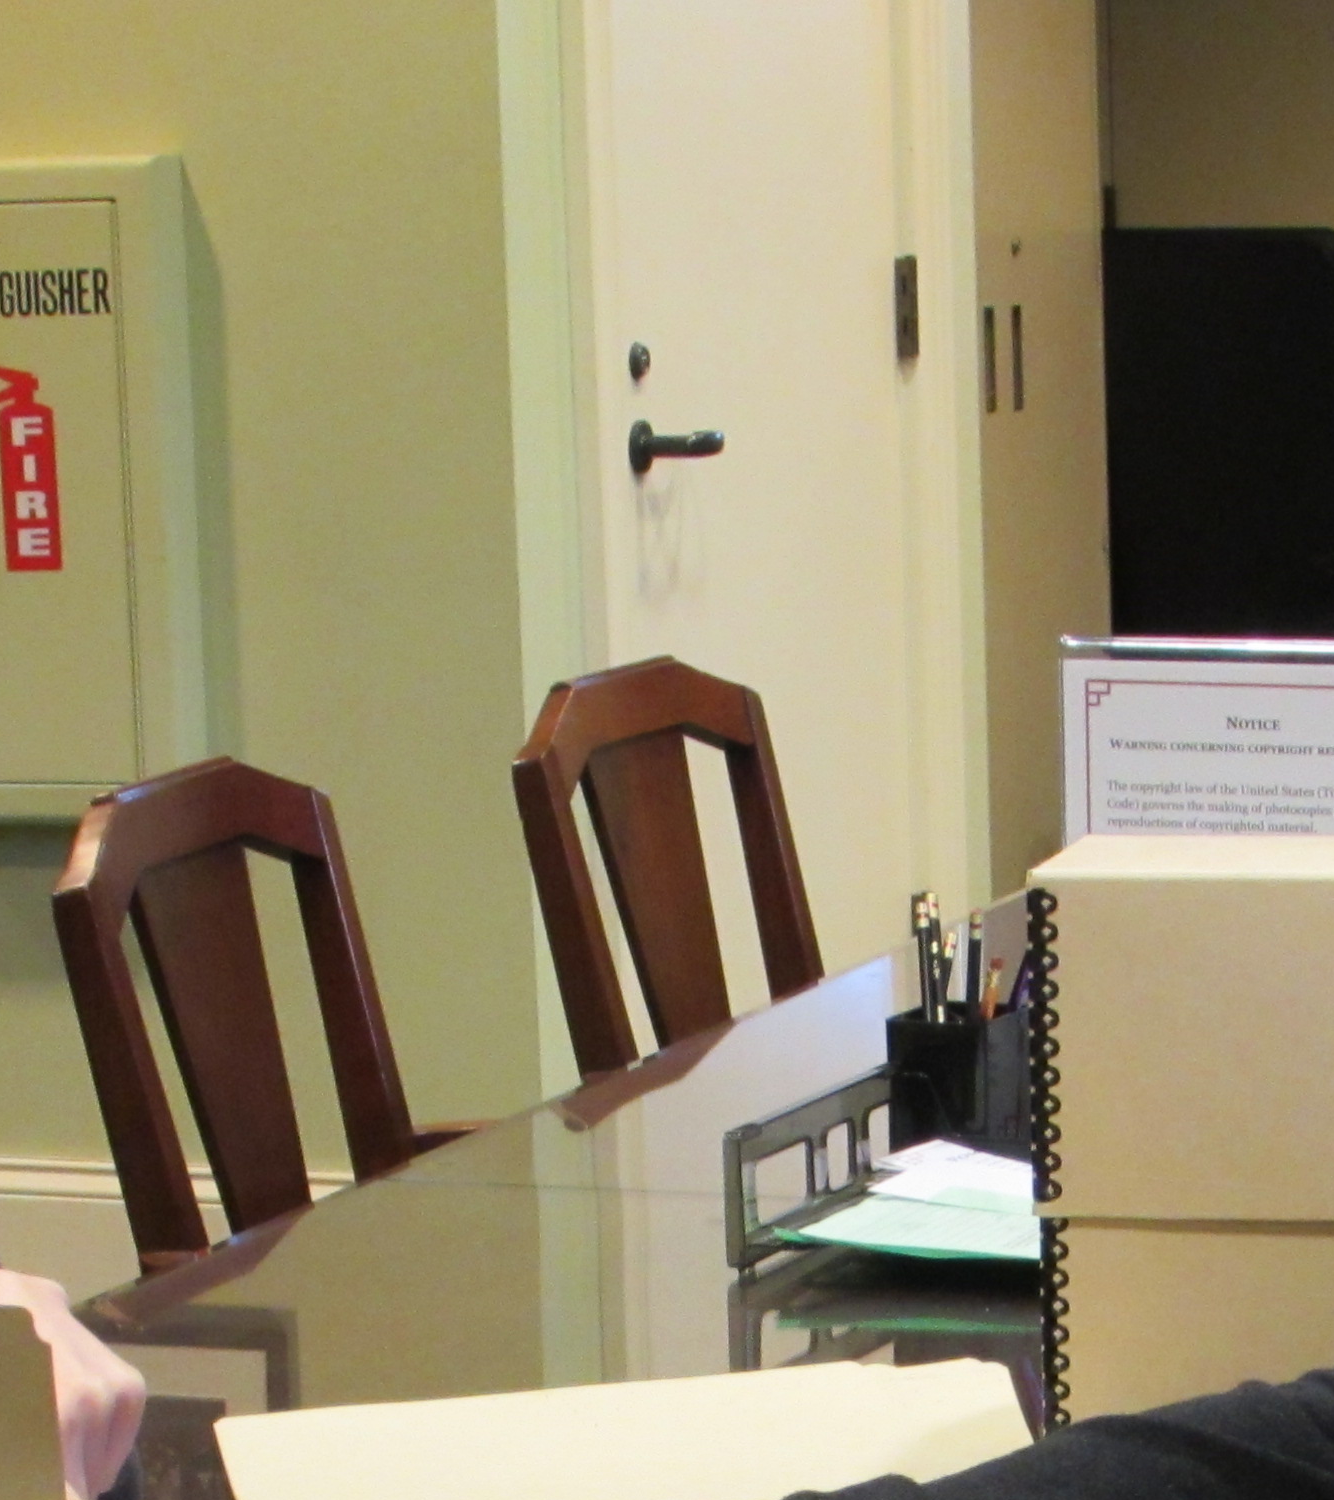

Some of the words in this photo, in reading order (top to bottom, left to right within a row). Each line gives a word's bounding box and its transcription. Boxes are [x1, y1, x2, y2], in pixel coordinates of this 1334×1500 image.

[10, 415, 52, 557] FIRE
[1107, 779, 1127, 792] The
[1130, 781, 1181, 795] copyright
[1185, 782, 1204, 793] law
[1206, 783, 1218, 794] of
[1220, 783, 1237, 795] the
[1241, 784, 1278, 797] United
[1281, 784, 1315, 798] States
[1107, 798, 1140, 811] Code)
[1142, 801, 1185, 812] governs
[1187, 799, 1204, 811] the
[1208, 800, 1249, 815] making
[1251, 802, 1263, 813] of
[1265, 803, 1333, 818] photocopies
[1107, 816, 1185, 829] reproductions
[1185, 818, 1198, 829] of
[1199, 818, 1265, 832] copyrighted
[1267, 821, 1317, 833] material.
